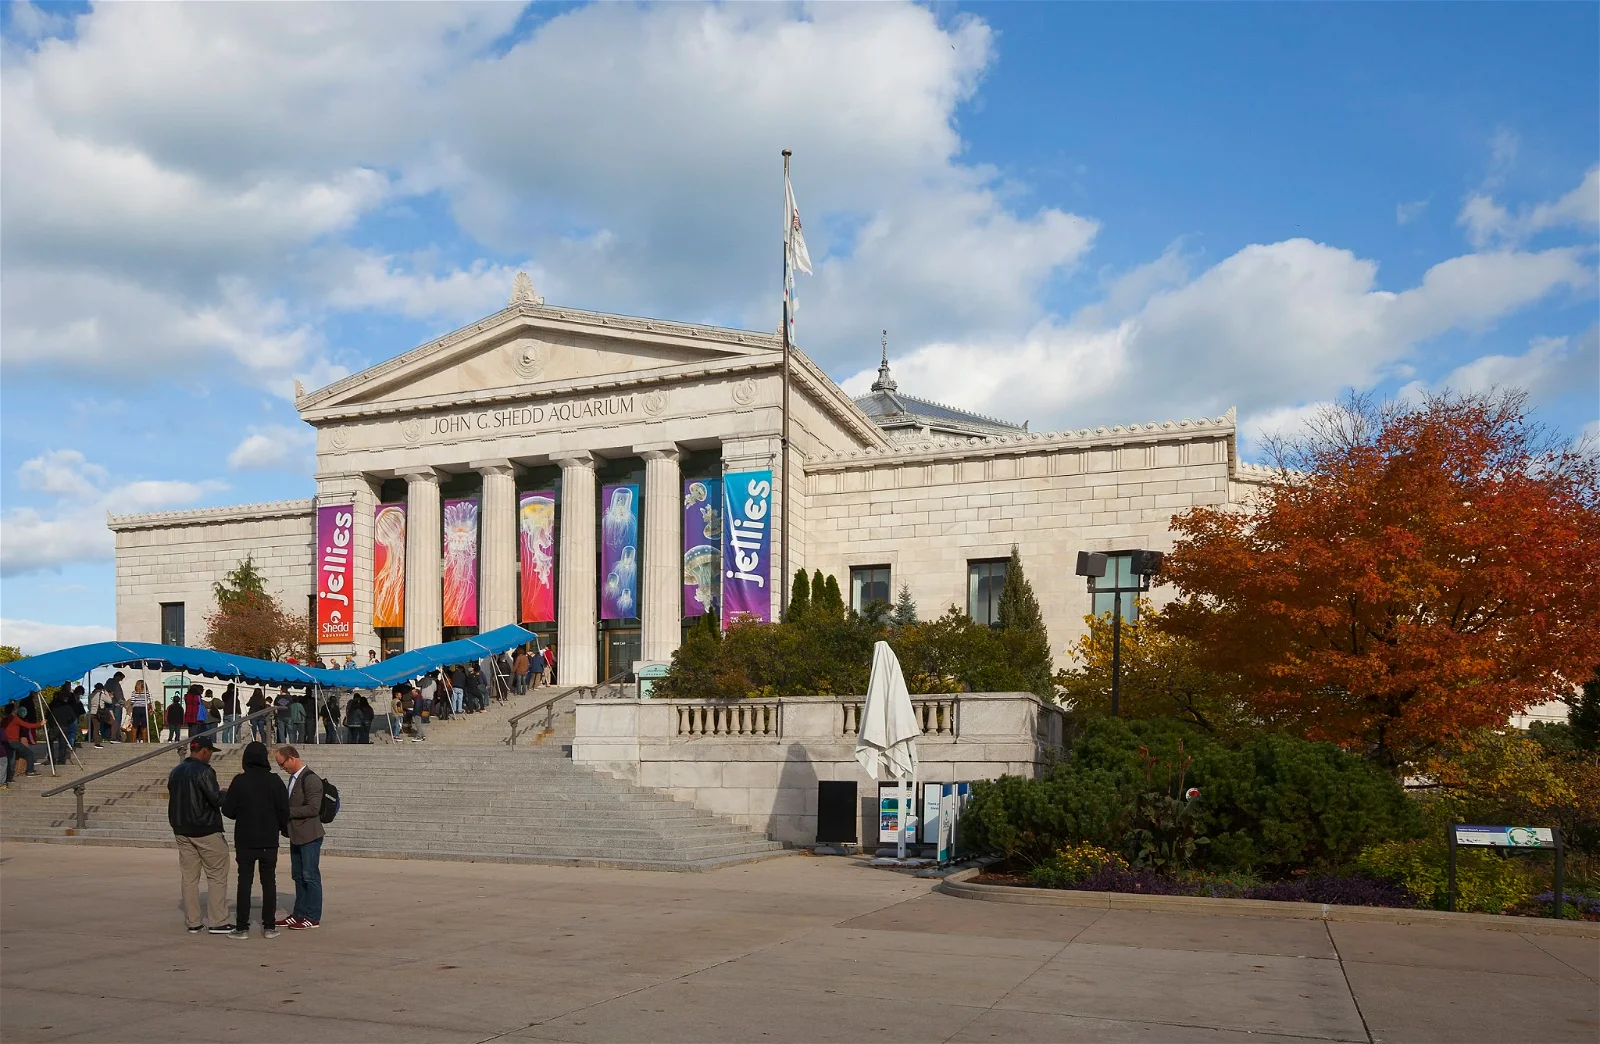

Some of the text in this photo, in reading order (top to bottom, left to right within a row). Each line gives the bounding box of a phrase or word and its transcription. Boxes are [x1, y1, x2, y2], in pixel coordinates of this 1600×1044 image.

[430, 397, 634, 435] JOHN G. SHEDD AQUARIUM
[320, 511, 352, 606] jellies
[726, 478, 771, 588] jellies
[322, 622, 349, 633] Shedd
